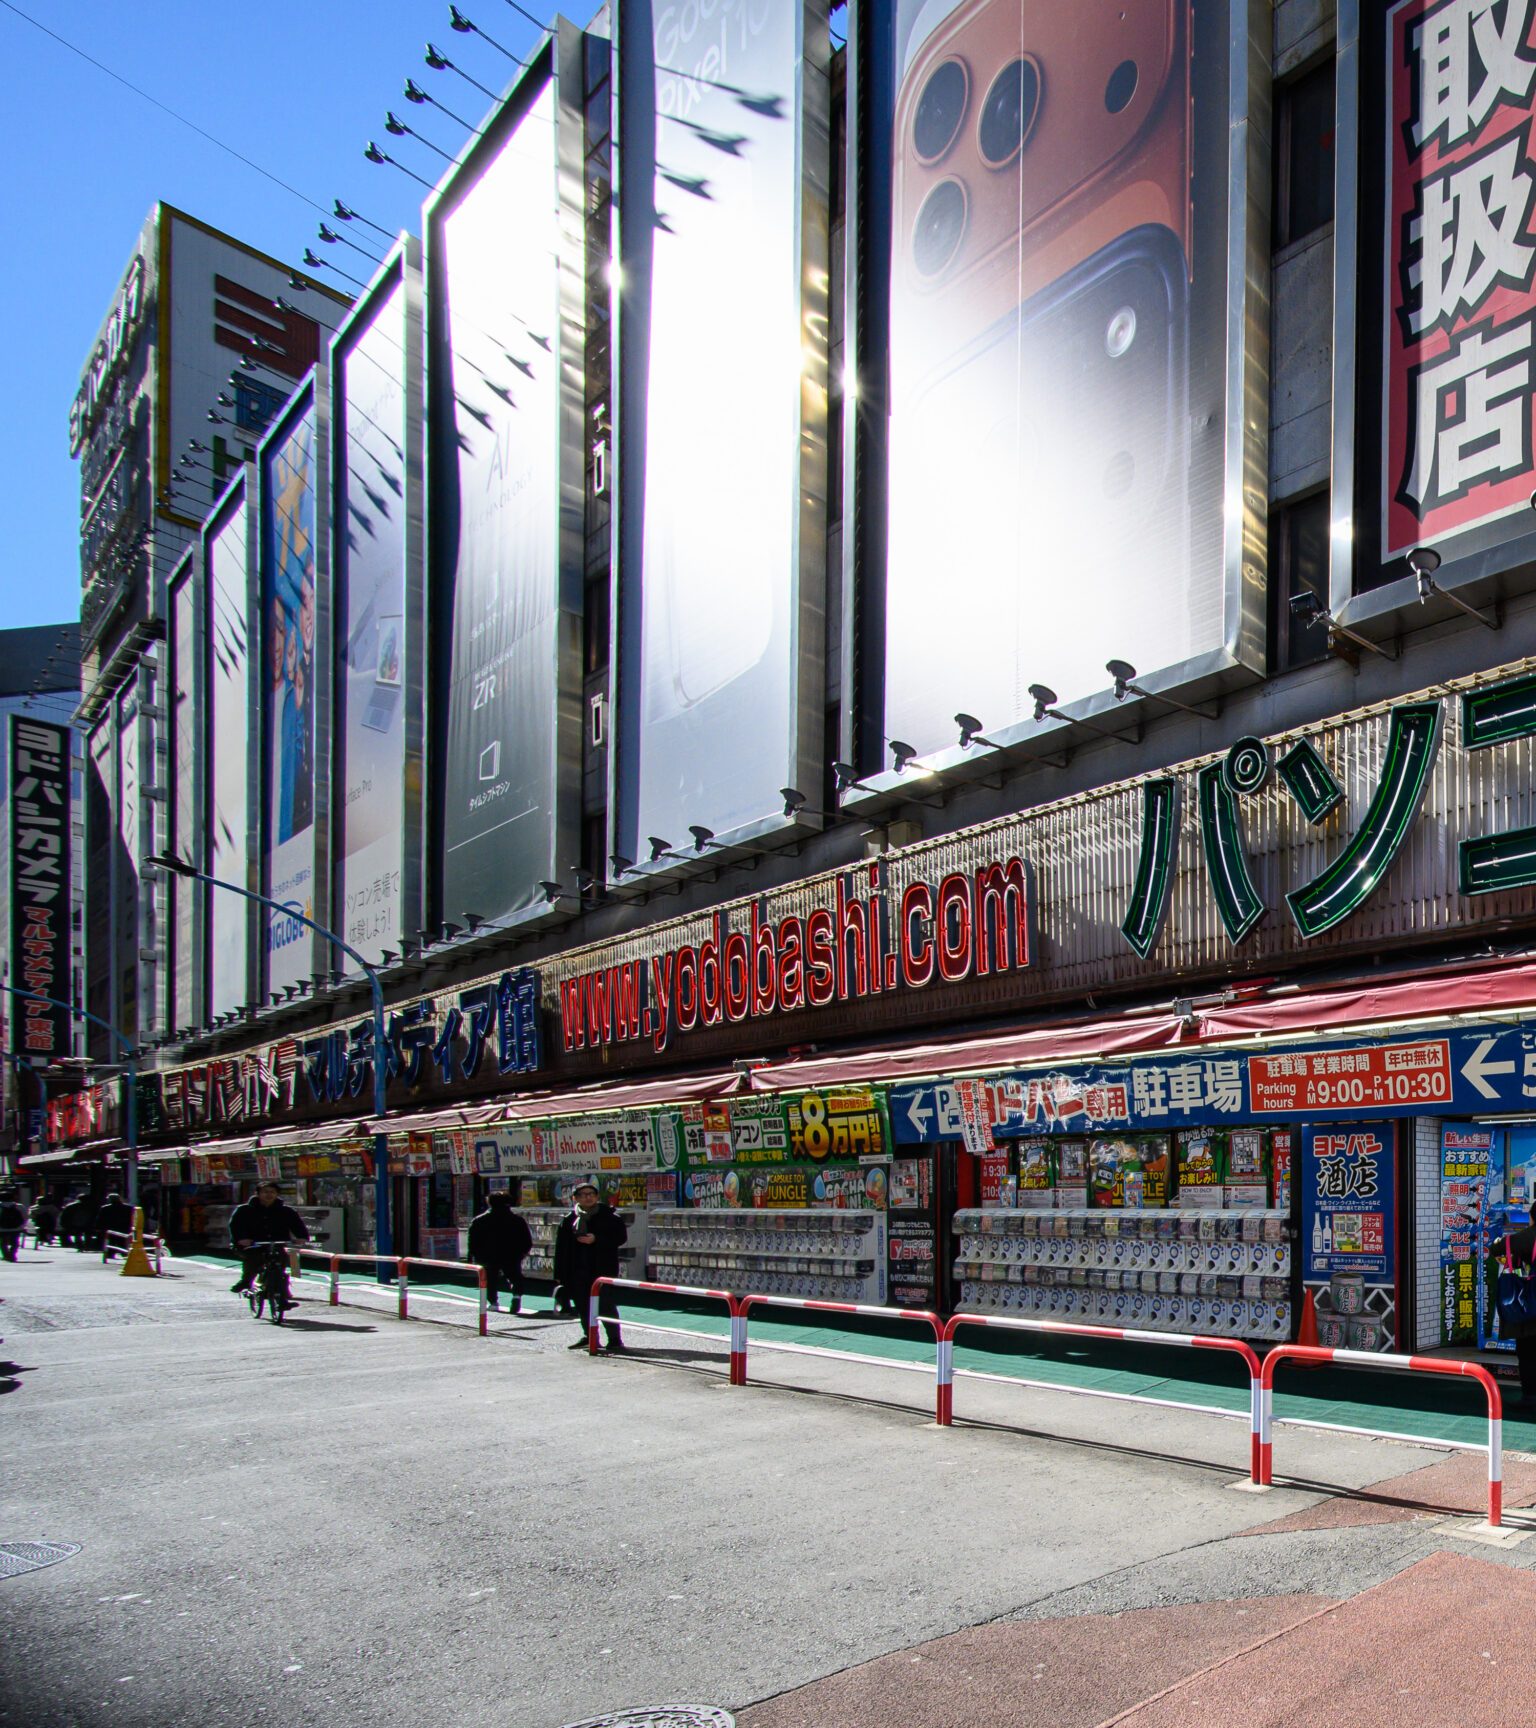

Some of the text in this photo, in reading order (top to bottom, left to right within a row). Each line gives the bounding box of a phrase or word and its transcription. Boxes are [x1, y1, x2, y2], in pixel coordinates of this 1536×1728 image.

[14, 722, 61, 905] ヨドバシカメラ
[560, 855, 1034, 1053] www.yodobashi.com
[22, 905, 57, 1053] マルチメディア東館
[1267, 1054, 1370, 1078] 駐車場 営業時間
[1388, 1049, 1441, 1067] 年中無休
[1133, 1058, 1242, 1118] 駐車場
[1257, 1082, 1296, 1098] Parking
[1384, 1072, 1446, 1101] 10:30
[1263, 1093, 1294, 1109] hours
[501, 1134, 597, 1161] www.yshi.com
[597, 1129, 654, 1154] で買えます!
[1313, 1132, 1384, 1157] ヨドバシ
[1444, 1131, 1491, 1145] 新しい生活
[1444, 1150, 1490, 1163] おすすめ
[793, 1173, 805, 1183] TOY
[989, 1165, 1007, 1177] 9:30
[1315, 1155, 1380, 1198] 酒店
[767, 1184, 807, 1200] JUNGLE
[1112, 1181, 1164, 1198] JUGLE
[1449, 1183, 1470, 1195] 照明
[1443, 1215, 1470, 1229] ドライヤー
[1450, 1231, 1471, 1244] テレビ
[1444, 1264, 1456, 1342] しております!
[1459, 1263, 1473, 1329] 展示・販売
